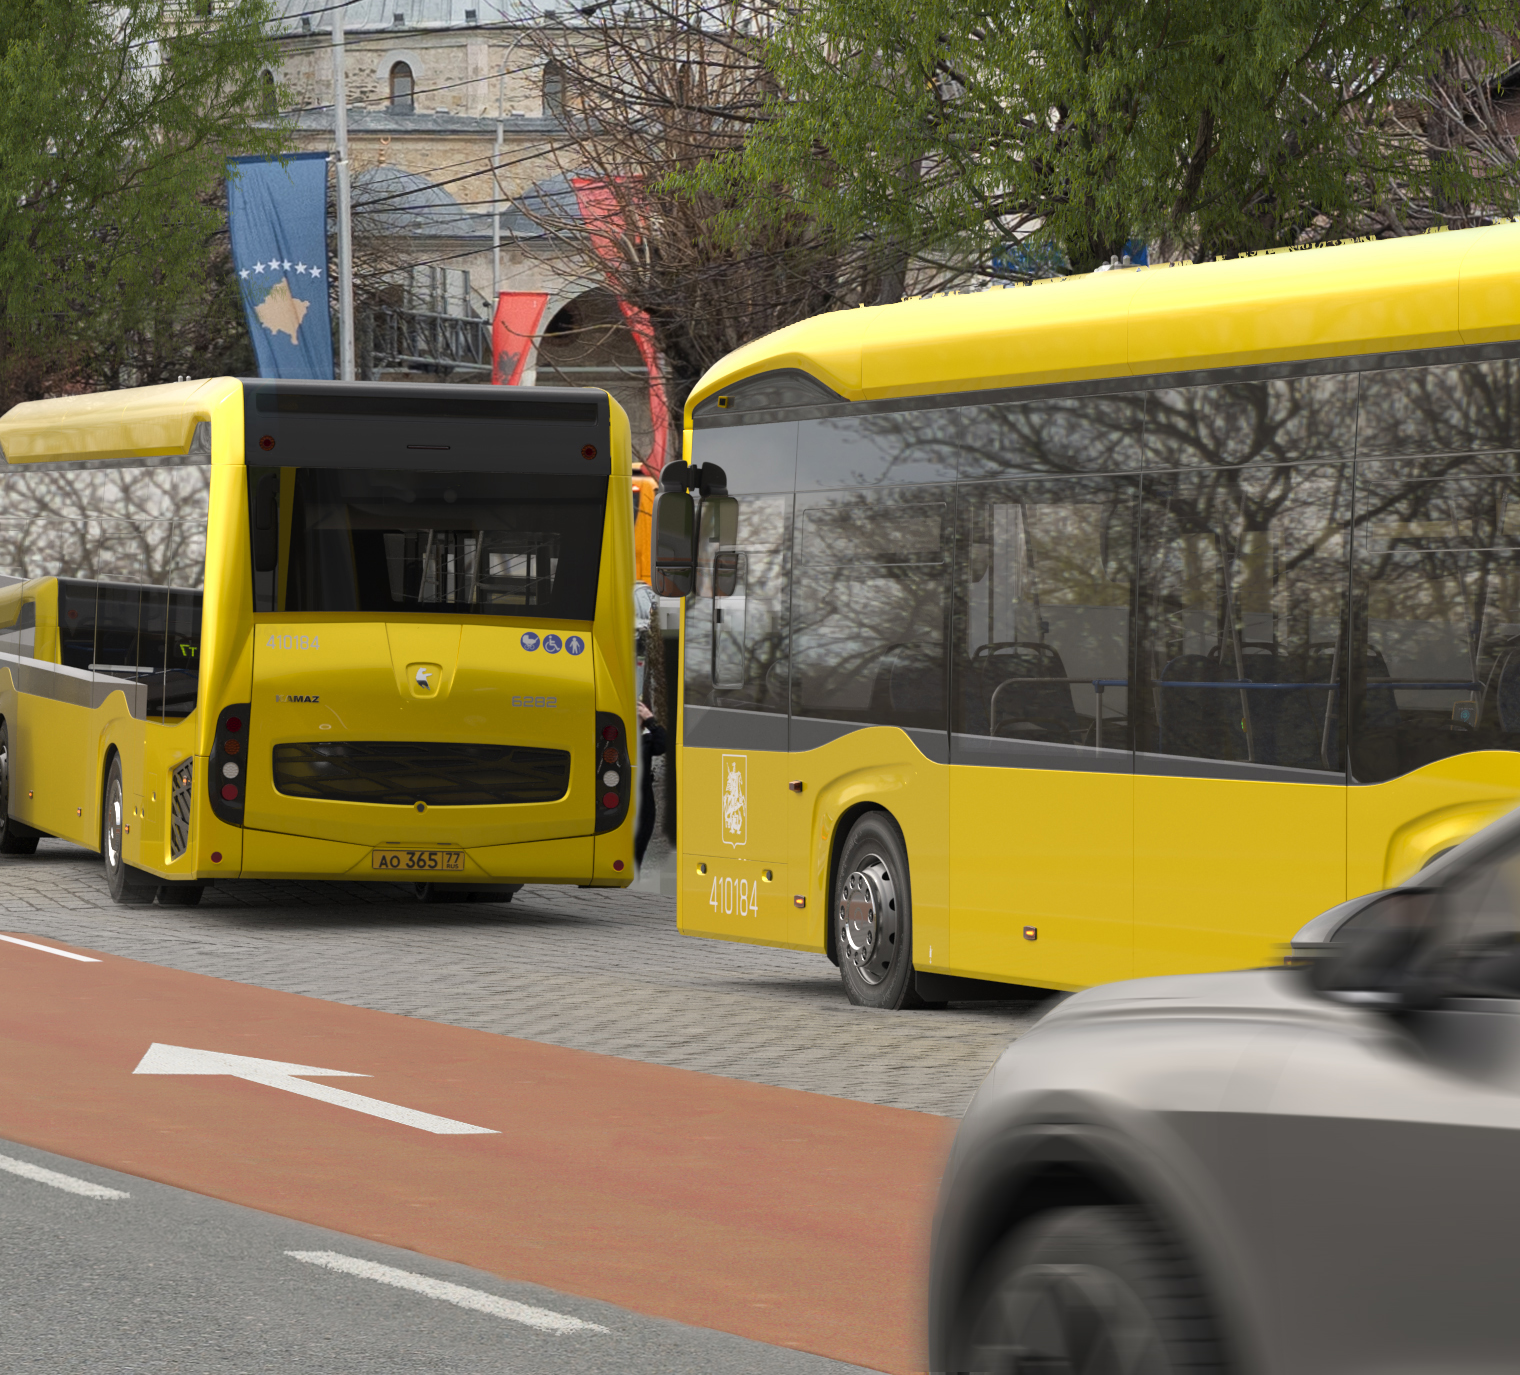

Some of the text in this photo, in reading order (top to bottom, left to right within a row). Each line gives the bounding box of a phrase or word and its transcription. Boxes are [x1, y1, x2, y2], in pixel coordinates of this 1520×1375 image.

[266, 635, 320, 650] 410184
[275, 695, 320, 703] KAMAZ
[511, 696, 557, 708] 6282
[405, 851, 438, 869] 365
[445, 852, 460, 864] 77
[709, 876, 758, 918] 410184
